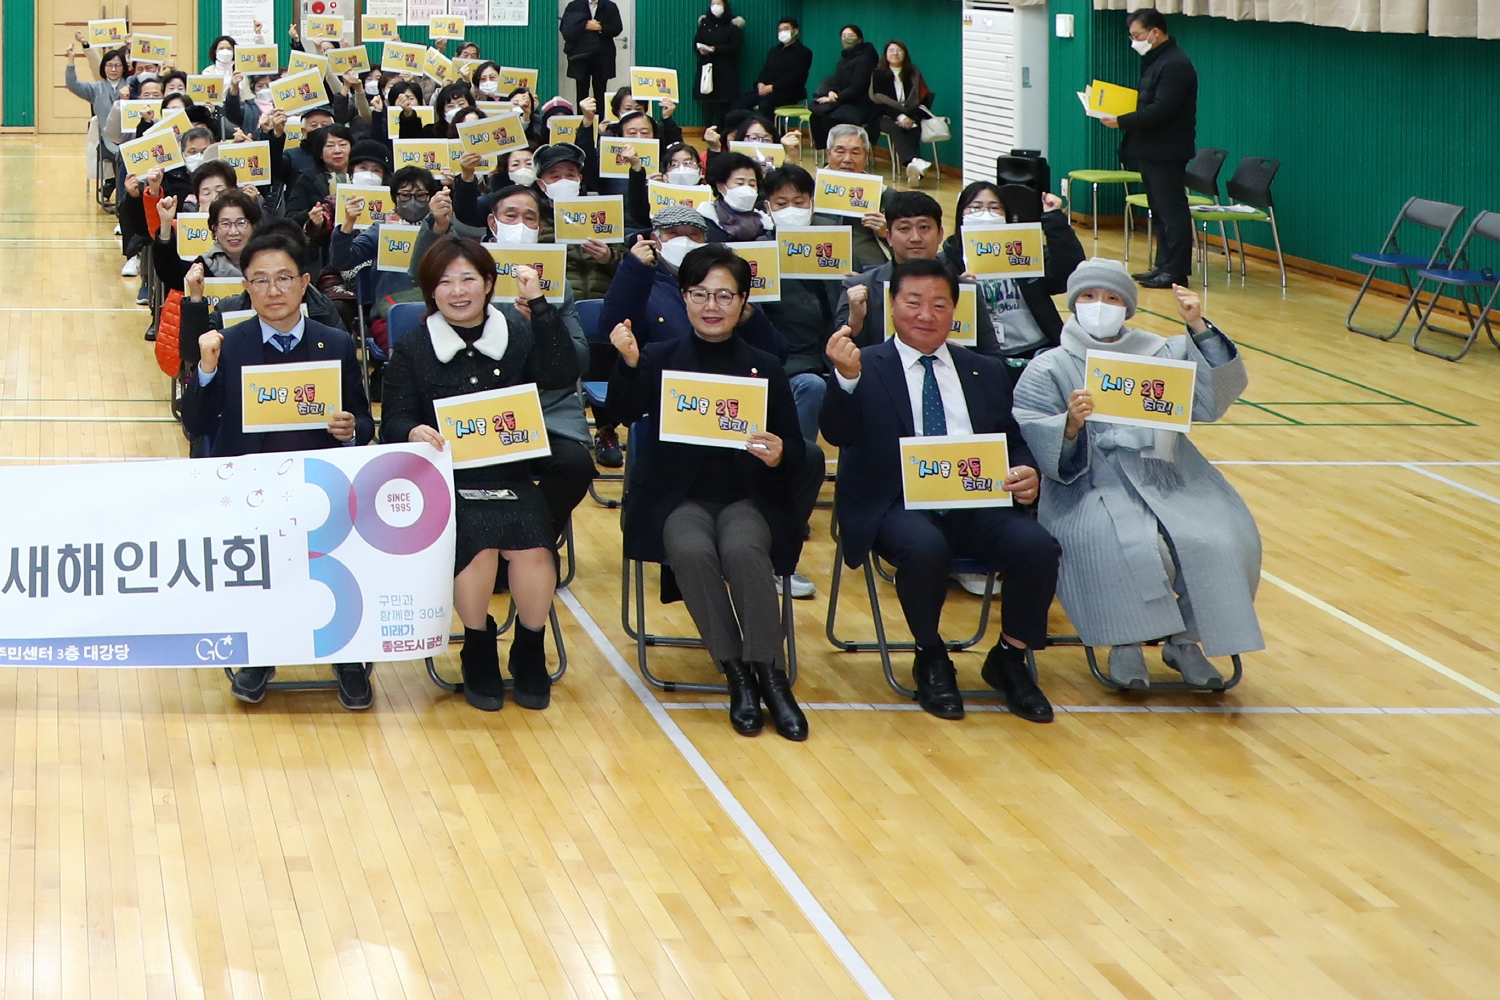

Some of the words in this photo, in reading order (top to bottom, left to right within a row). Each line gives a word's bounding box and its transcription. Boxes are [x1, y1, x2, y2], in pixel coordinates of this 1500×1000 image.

[977, 242, 1000, 256] 시흥
[1005, 241, 1022, 255] 2동
[258, 387, 288, 403] 시흥
[294, 384, 316, 402] 2동
[1101, 374, 1135, 395] 시흥
[1141, 380, 1165, 399] 2동
[297, 402, 325, 415] 최고!
[677, 395, 710, 415] 시흥
[716, 399, 739, 417] 2동
[1143, 397, 1173, 415] 최고!
[456, 418, 487, 438] 시흥
[492, 411, 517, 431] 2동
[718, 416, 747, 434] 최고!
[500, 430, 529, 446] 최고!
[919, 460, 951, 478] 시흥
[957, 457, 981, 477] 2동
[962, 476, 992, 491] 최고!
[387, 493, 411, 502] SINCE
[391, 503, 412, 512] 1995
[1, 534, 271, 598] 새해인사회
[379, 594, 414, 607] 구민과
[380, 609, 414, 622] 함께한
[381, 624, 415, 637] 미래가
[57, 645, 79, 661] 3층
[83, 644, 130, 661] 대강당
[382, 639, 425, 653] 좋은도시
[427, 635, 443, 649] 금천
